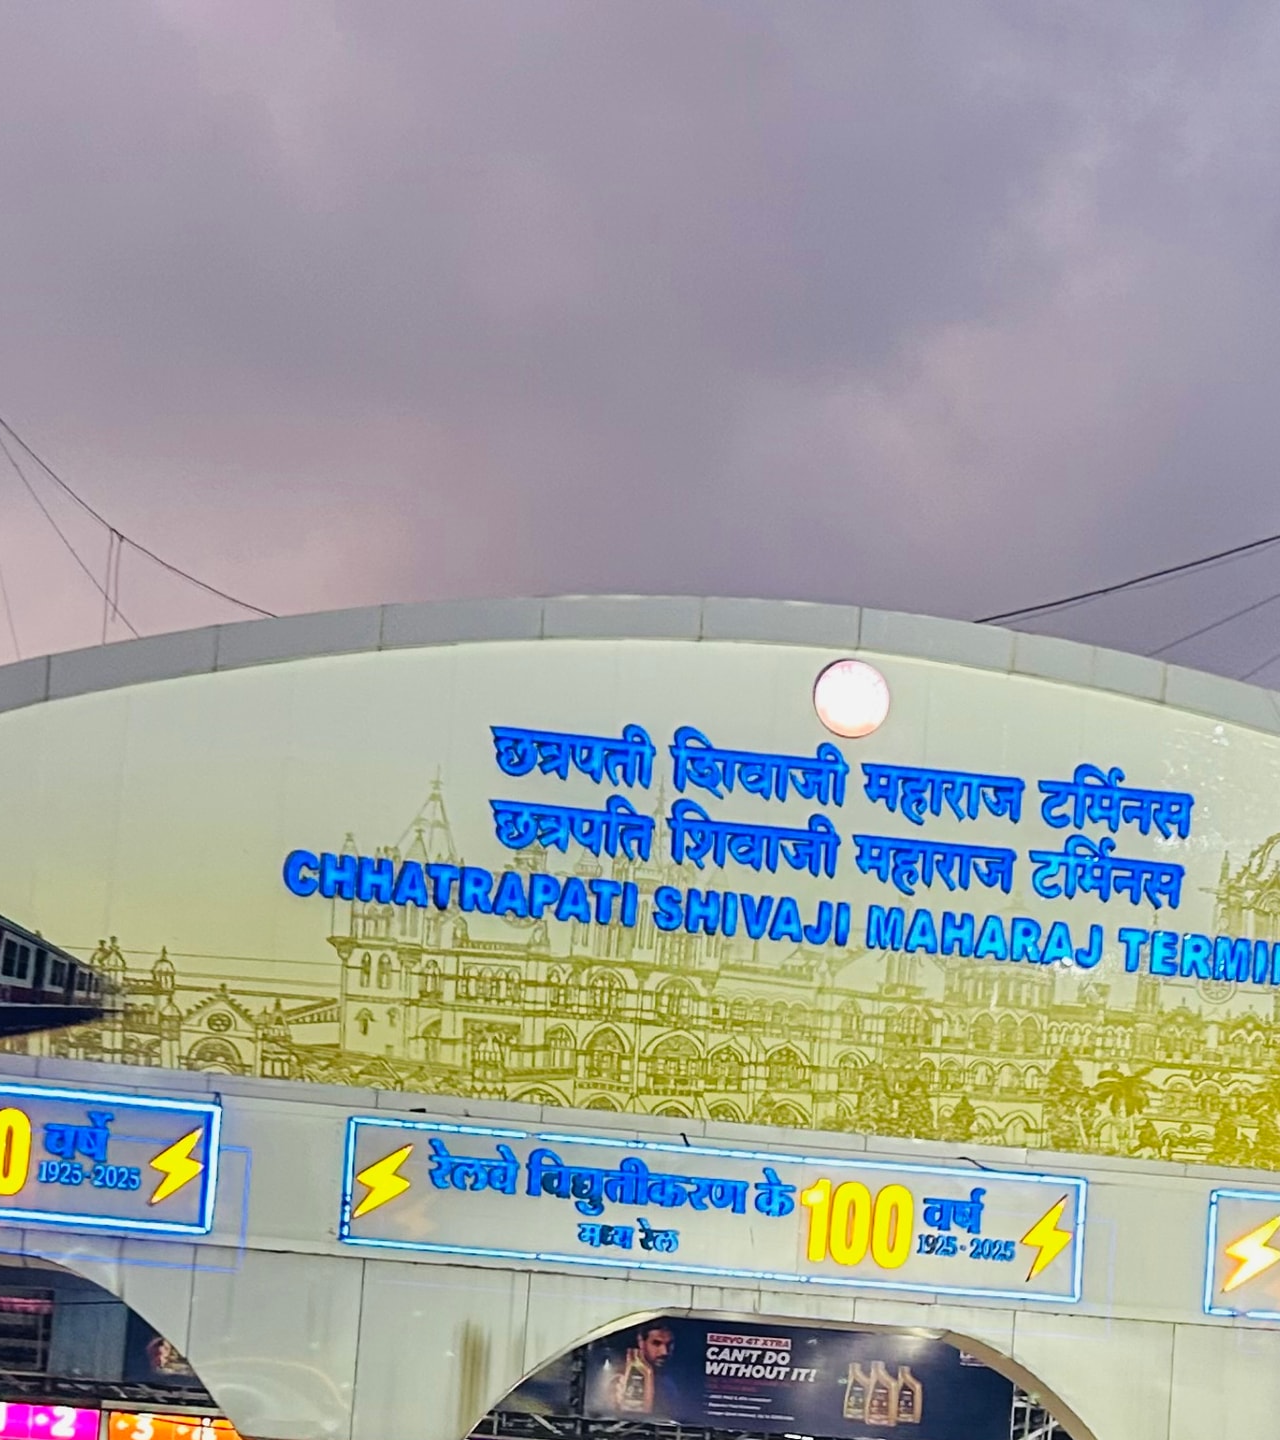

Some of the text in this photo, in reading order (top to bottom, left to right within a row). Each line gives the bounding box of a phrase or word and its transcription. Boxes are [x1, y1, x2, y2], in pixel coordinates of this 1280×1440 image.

[489, 723, 1194, 839] छत्रपती शिवाजी महाराज टर्मिनस
[488, 794, 1185, 910] छत्रपति शिवाजी महाराज टर्मिनस
[283, 850, 637, 927] CHHATRAPATI
[653, 885, 850, 946] SHIVAJI
[866, 904, 1103, 968] MAHARAJ
[428, 1138, 987, 1269] रेलवे विद्युतीकरण के 100 वर्ष
[578, 1217, 680, 1253] मध्य रेल
[706, 1346, 790, 1366] CAN'T DO
[708, 1334, 743, 1344] SERVO
[761, 1338, 789, 1348] XTRA
[705, 1361, 817, 1382] WITHOUT IT!
[50, 1406, 77, 1437] 2
